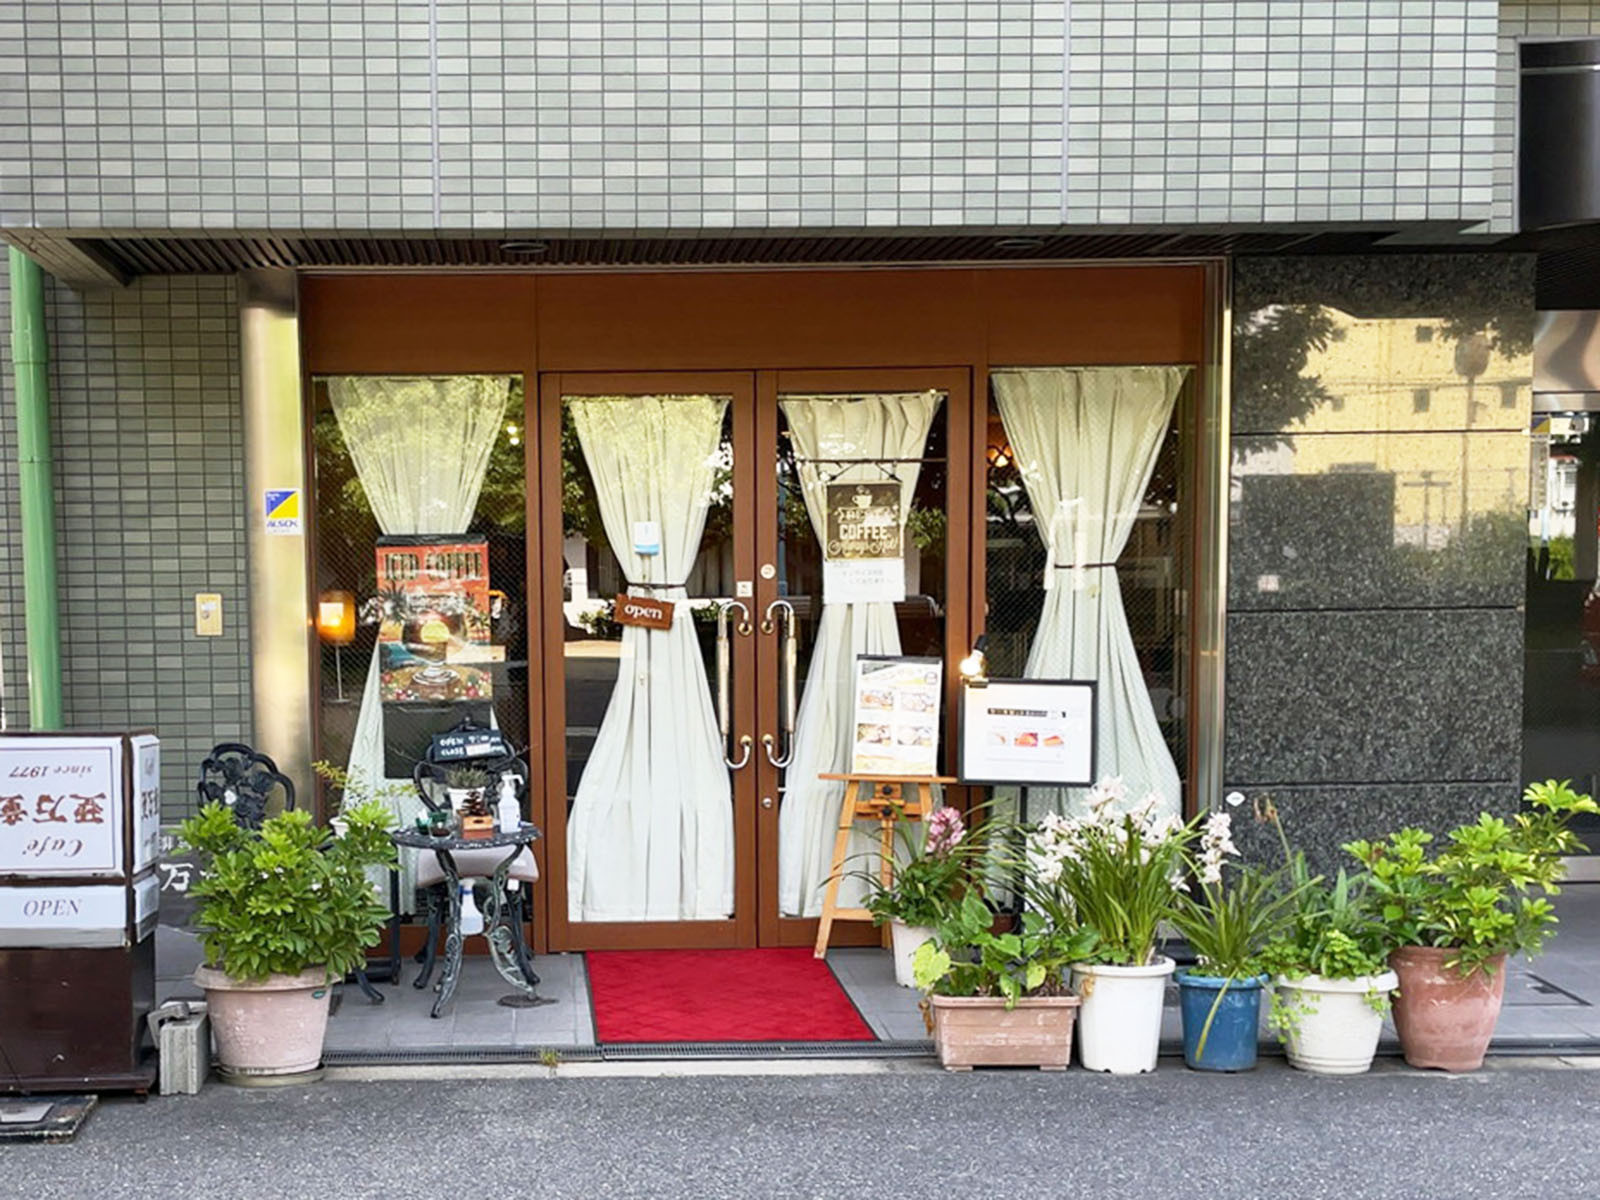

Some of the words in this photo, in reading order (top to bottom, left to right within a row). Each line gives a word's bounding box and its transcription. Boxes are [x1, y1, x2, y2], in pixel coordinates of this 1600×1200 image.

[839, 524, 888, 540] COFFEE
[624, 603, 663, 620] open
[8, 766, 49, 778] 1977
[53, 765, 93, 778] since
[23, 899, 82, 916] OPEN
